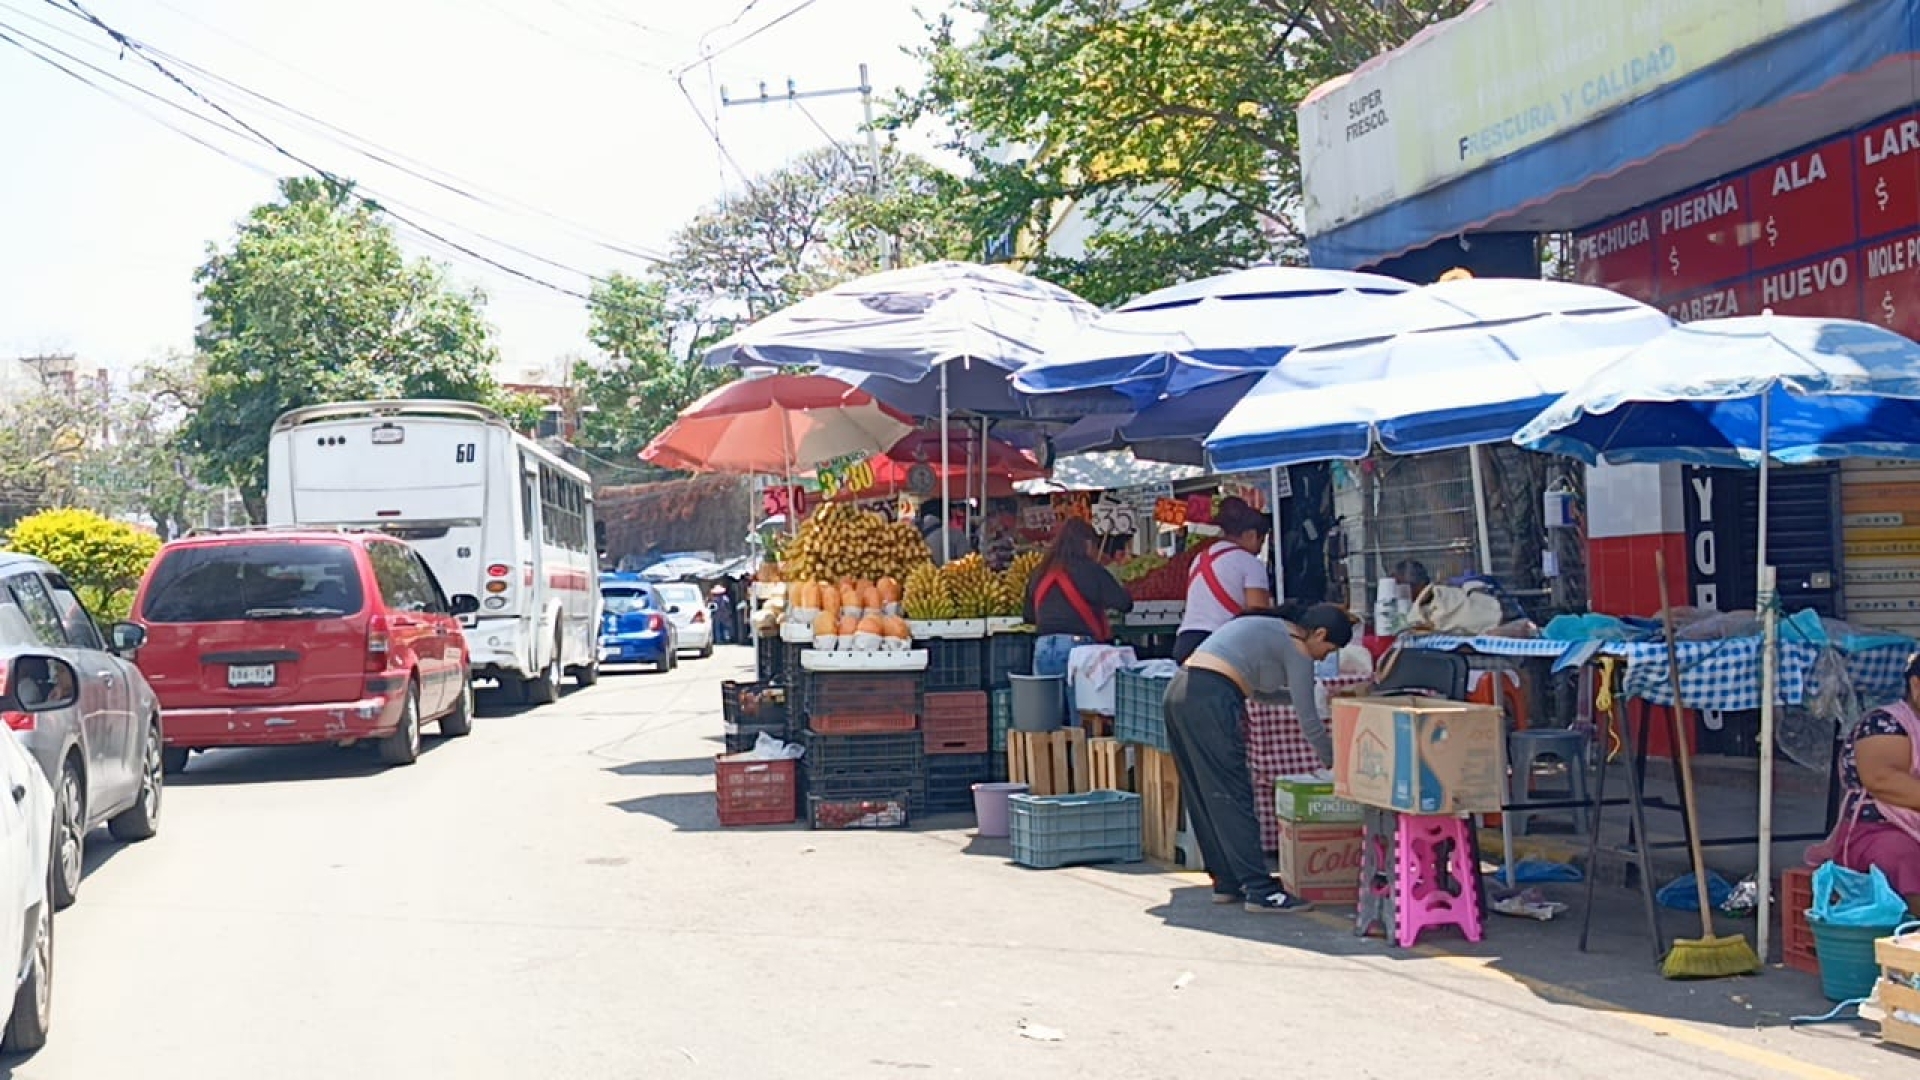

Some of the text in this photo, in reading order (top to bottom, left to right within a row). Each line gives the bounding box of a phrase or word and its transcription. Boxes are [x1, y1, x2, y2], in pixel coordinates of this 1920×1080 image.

[1349, 89, 1382, 119] SUPER
[1459, 101, 1557, 160] FRESCURA
[1560, 88, 1574, 115] Y
[1580, 43, 1677, 107] CALIDAD
[1346, 109, 1389, 142] FRESCO.
[1771, 153, 1827, 196] ALA
[1874, 177, 1889, 211] $
[1579, 217, 1650, 262] PECHUGA
[1766, 215, 1778, 247] $
[1668, 246, 1681, 276] $
[1868, 241, 1906, 278] MOLE
[1763, 257, 1849, 304] HUEVO
[1881, 289, 1896, 324] $
[456, 443, 475, 463] 60
